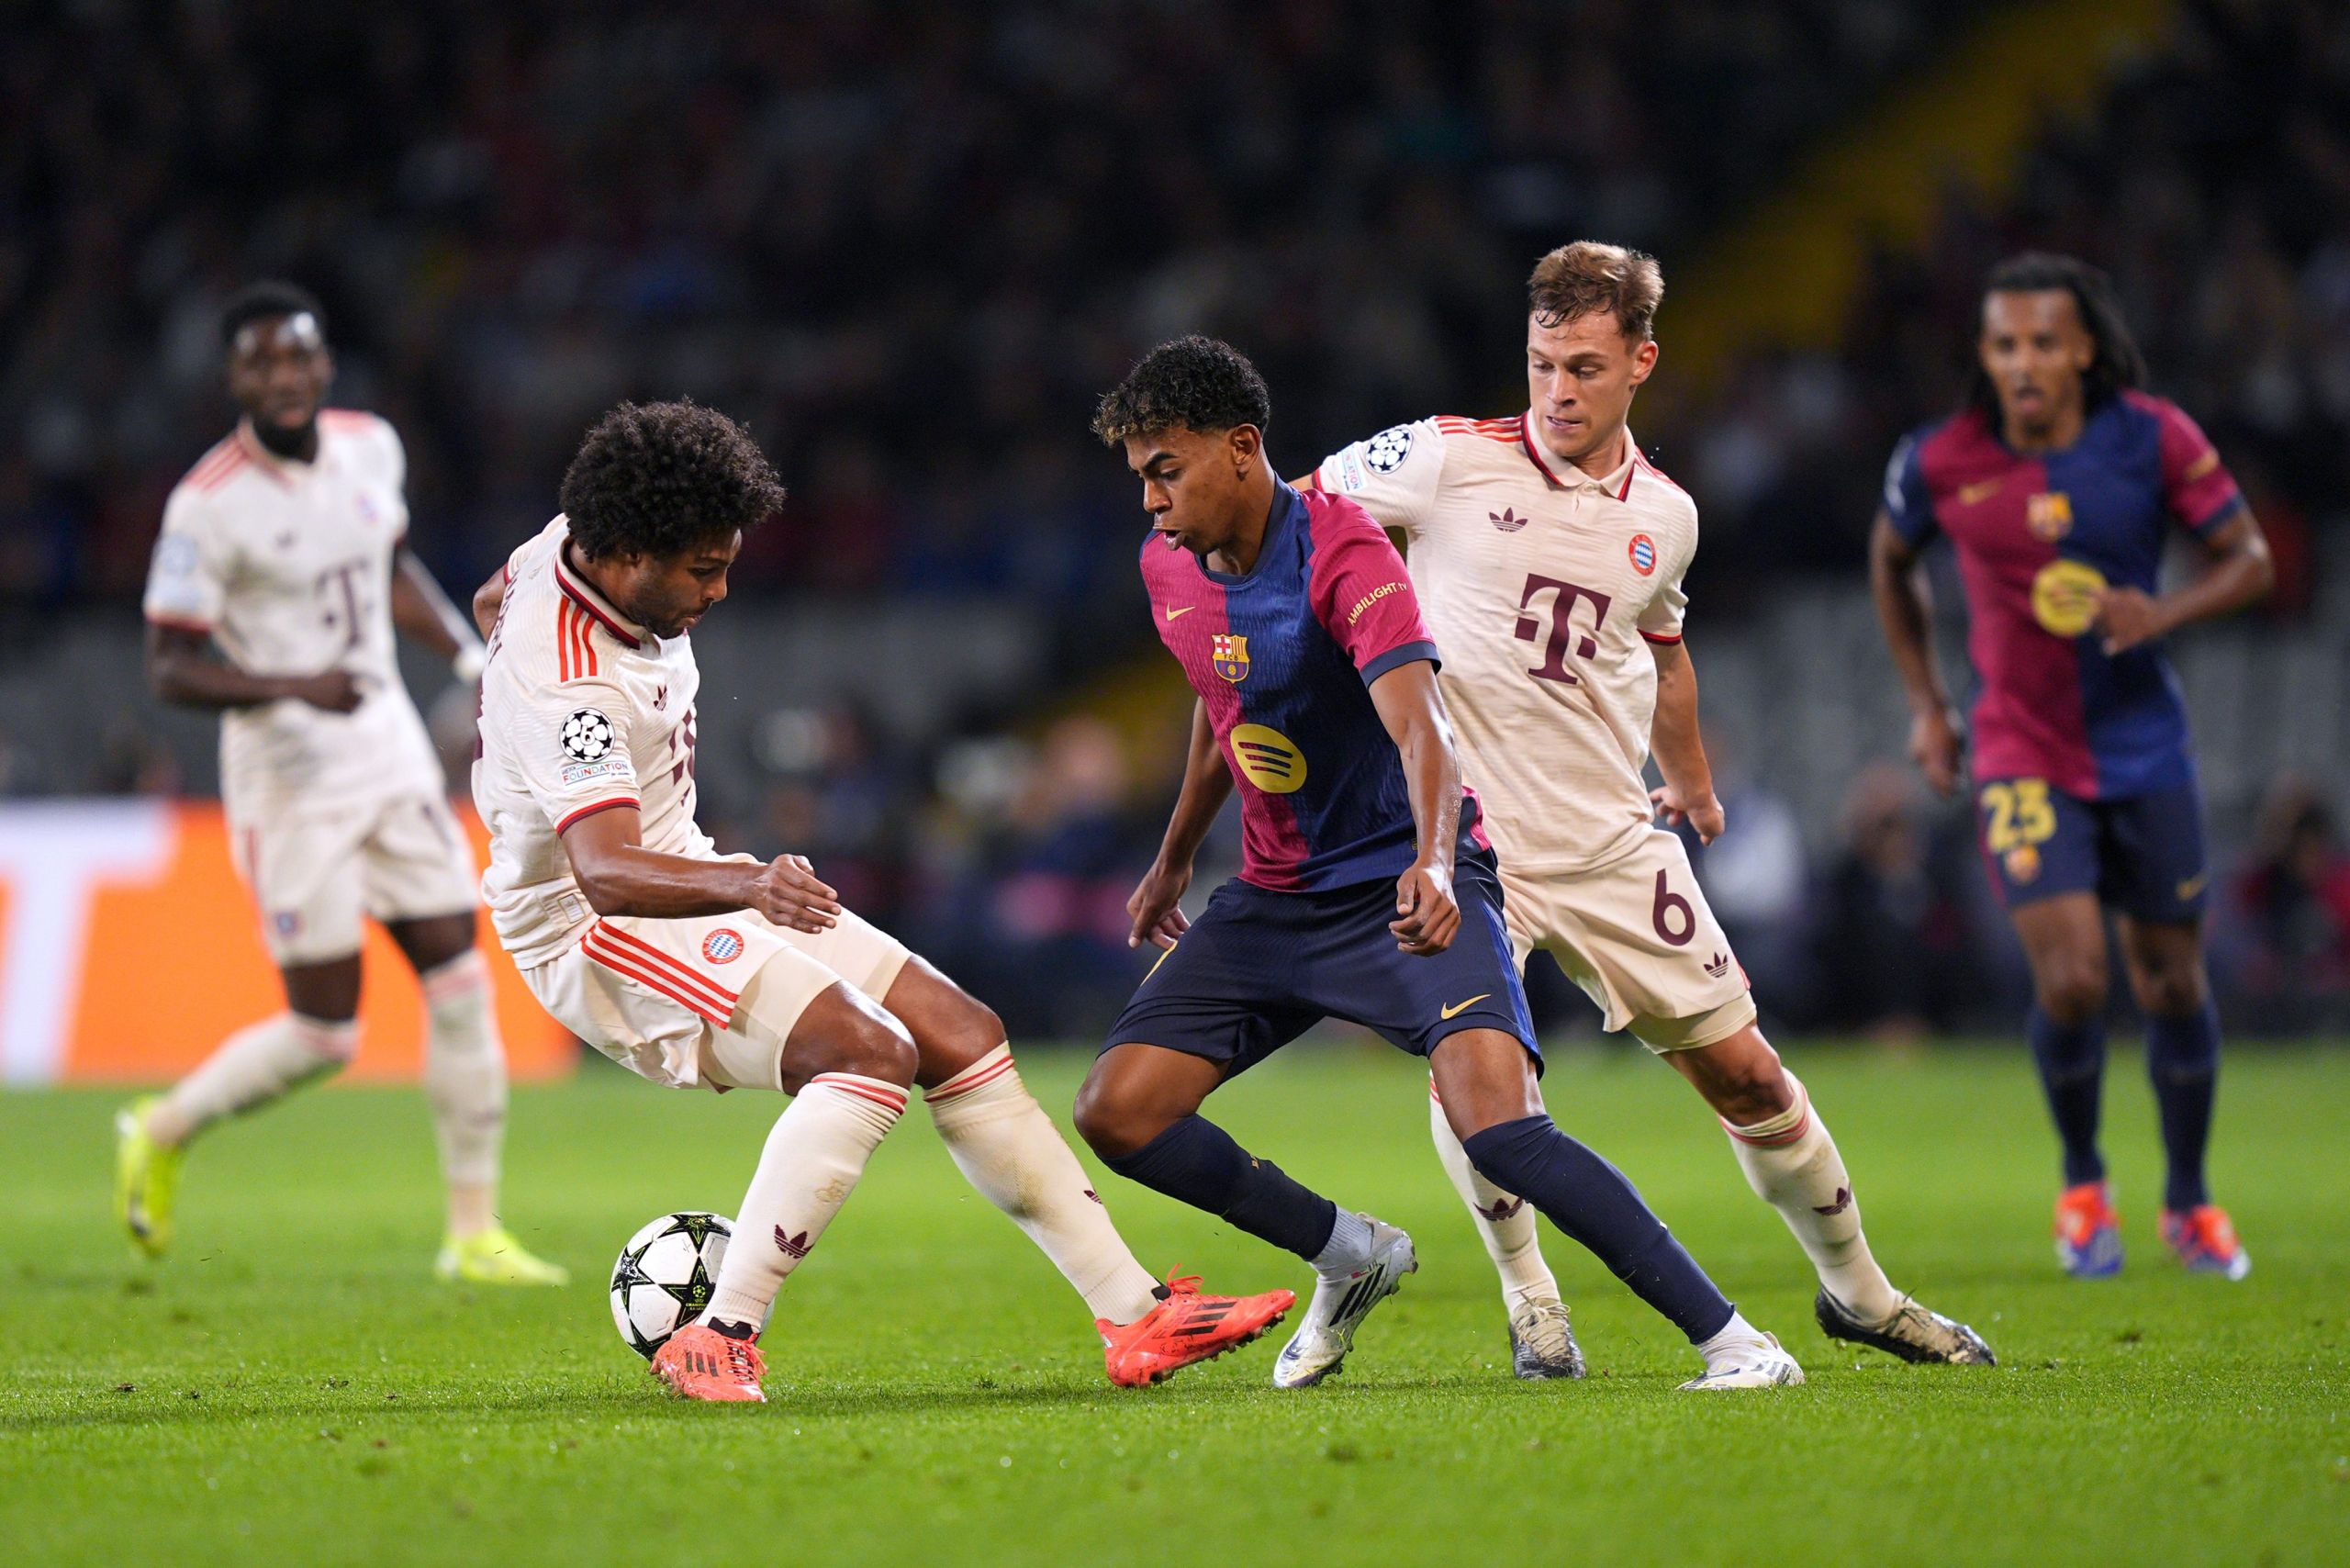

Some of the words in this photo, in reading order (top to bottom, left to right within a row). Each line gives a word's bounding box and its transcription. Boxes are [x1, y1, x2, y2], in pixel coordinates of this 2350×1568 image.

[1348, 582, 1397, 627] AMBILIGHT
[1397, 582, 1407, 591] tv
[1515, 573, 1611, 685] T
[563, 762, 629, 783] FOUNDATION
[1980, 778, 2056, 851] 23
[1652, 868, 1695, 946] 6
